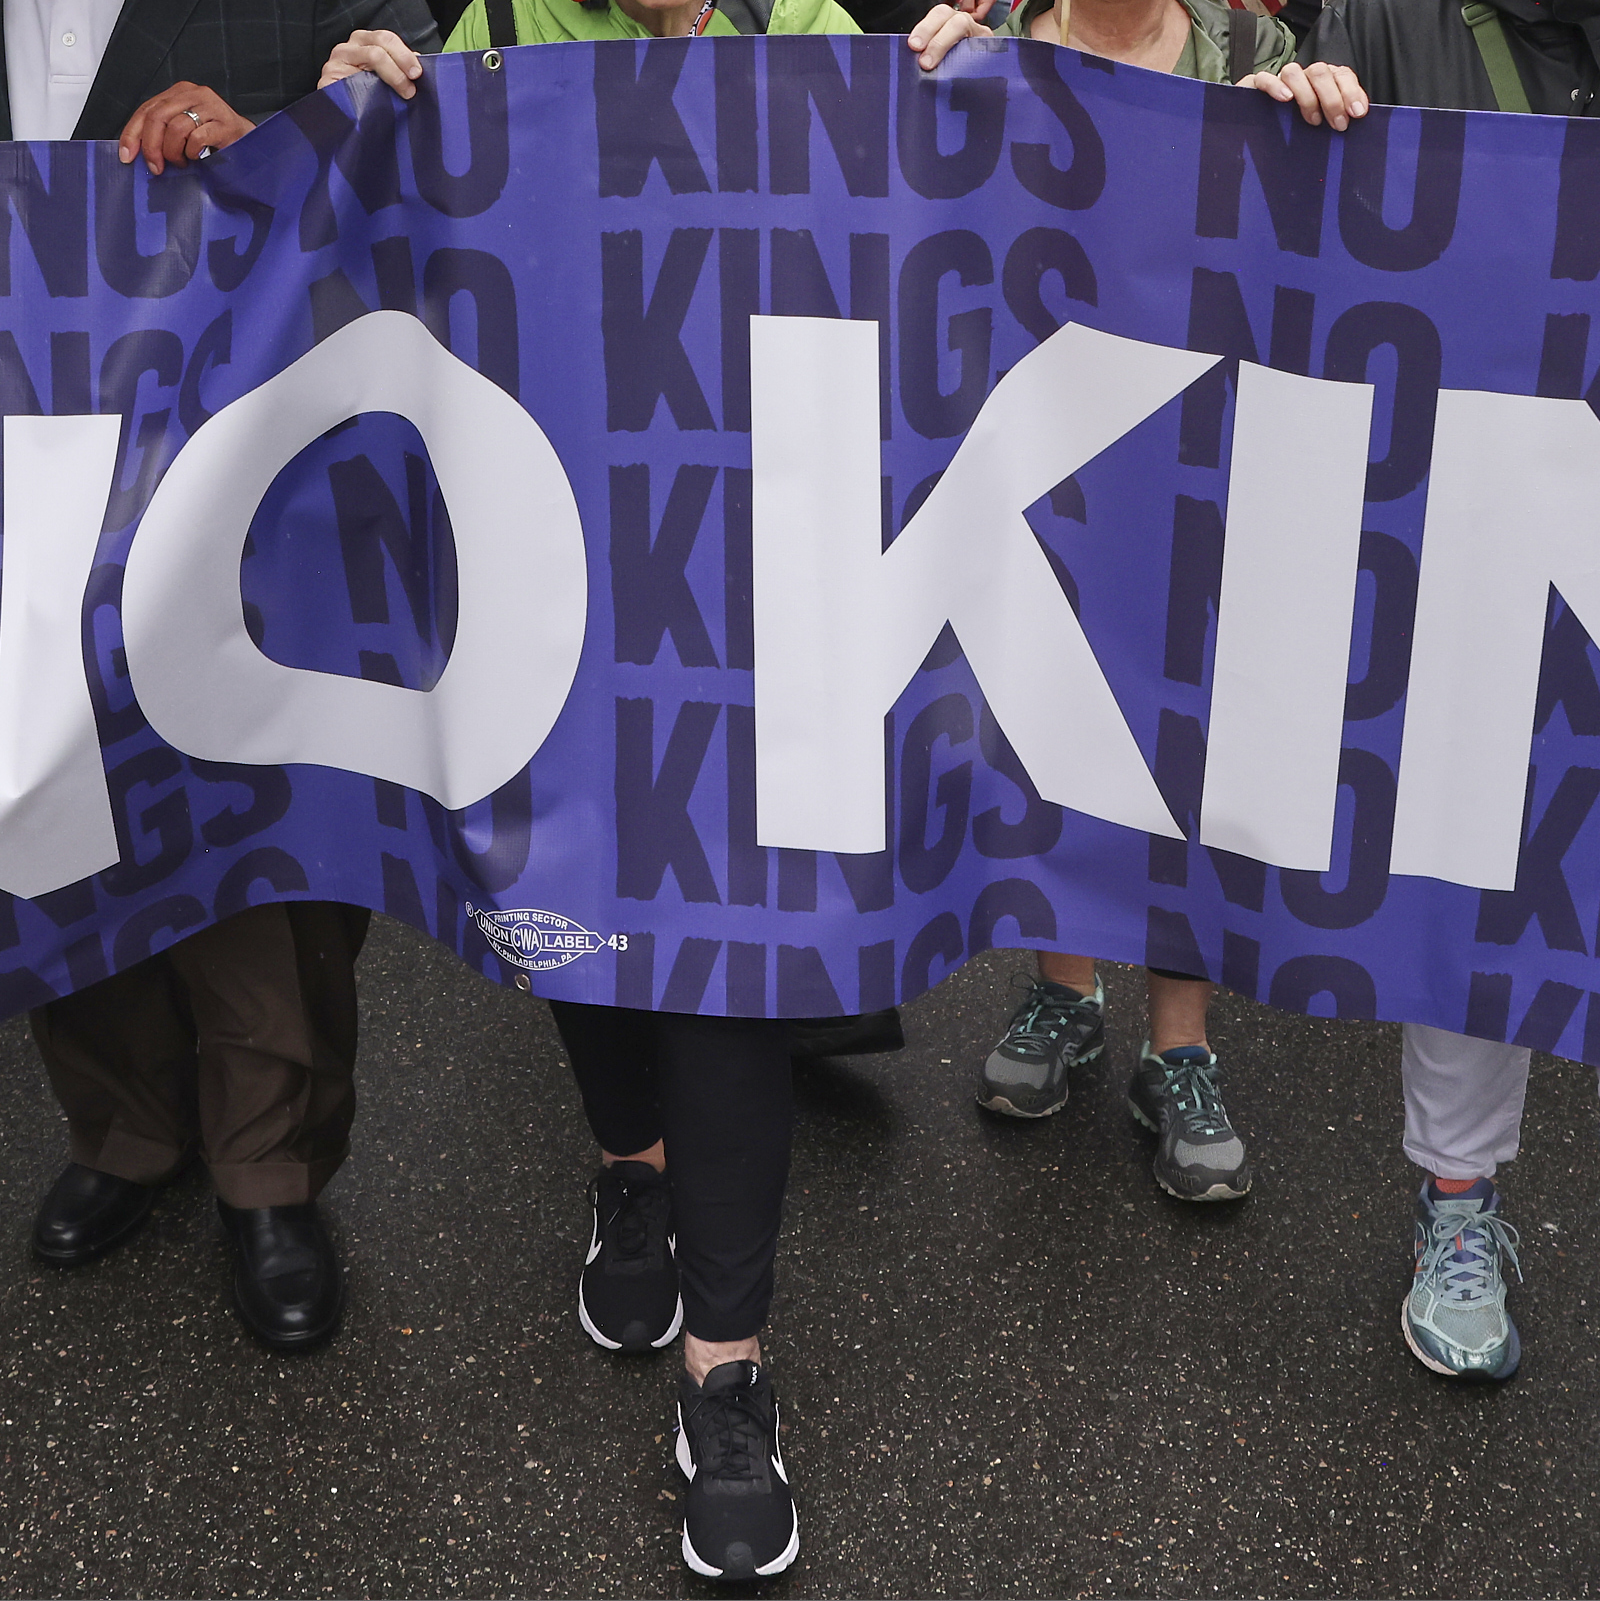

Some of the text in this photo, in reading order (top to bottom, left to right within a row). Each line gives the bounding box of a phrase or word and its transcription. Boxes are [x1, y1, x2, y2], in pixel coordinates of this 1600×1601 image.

[596, 36, 1106, 209] KINGS
[1196, 83, 1464, 272] NO
[494, 912, 568, 930] PRINTING SECTOR
[480, 914, 594, 951] UNION CWA LABEL
[607, 934, 629, 951] 43
[561, 952, 573, 963] PA
